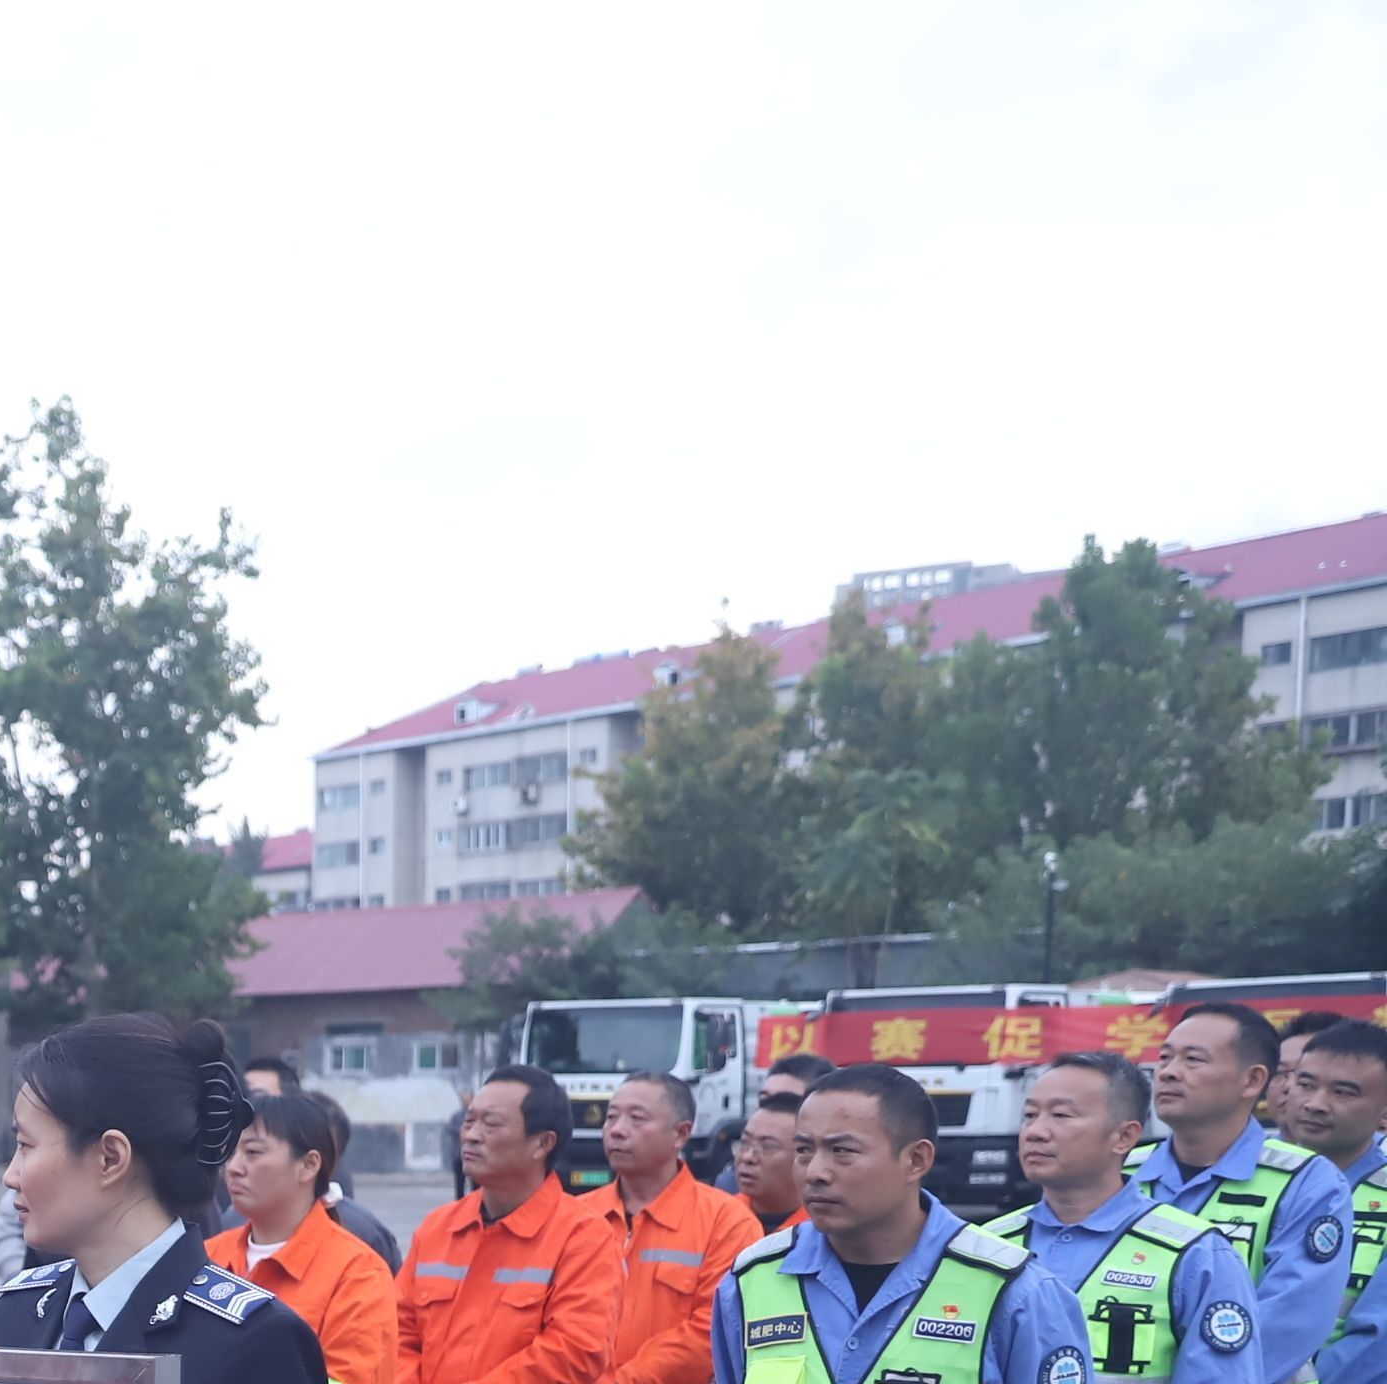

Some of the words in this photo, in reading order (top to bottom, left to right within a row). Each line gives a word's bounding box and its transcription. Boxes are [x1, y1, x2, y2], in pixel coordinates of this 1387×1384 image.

[1106, 1271, 1153, 1287] 002536
[749, 1320, 802, 1341] 城肥中心
[918, 1321, 974, 1338] 002206
